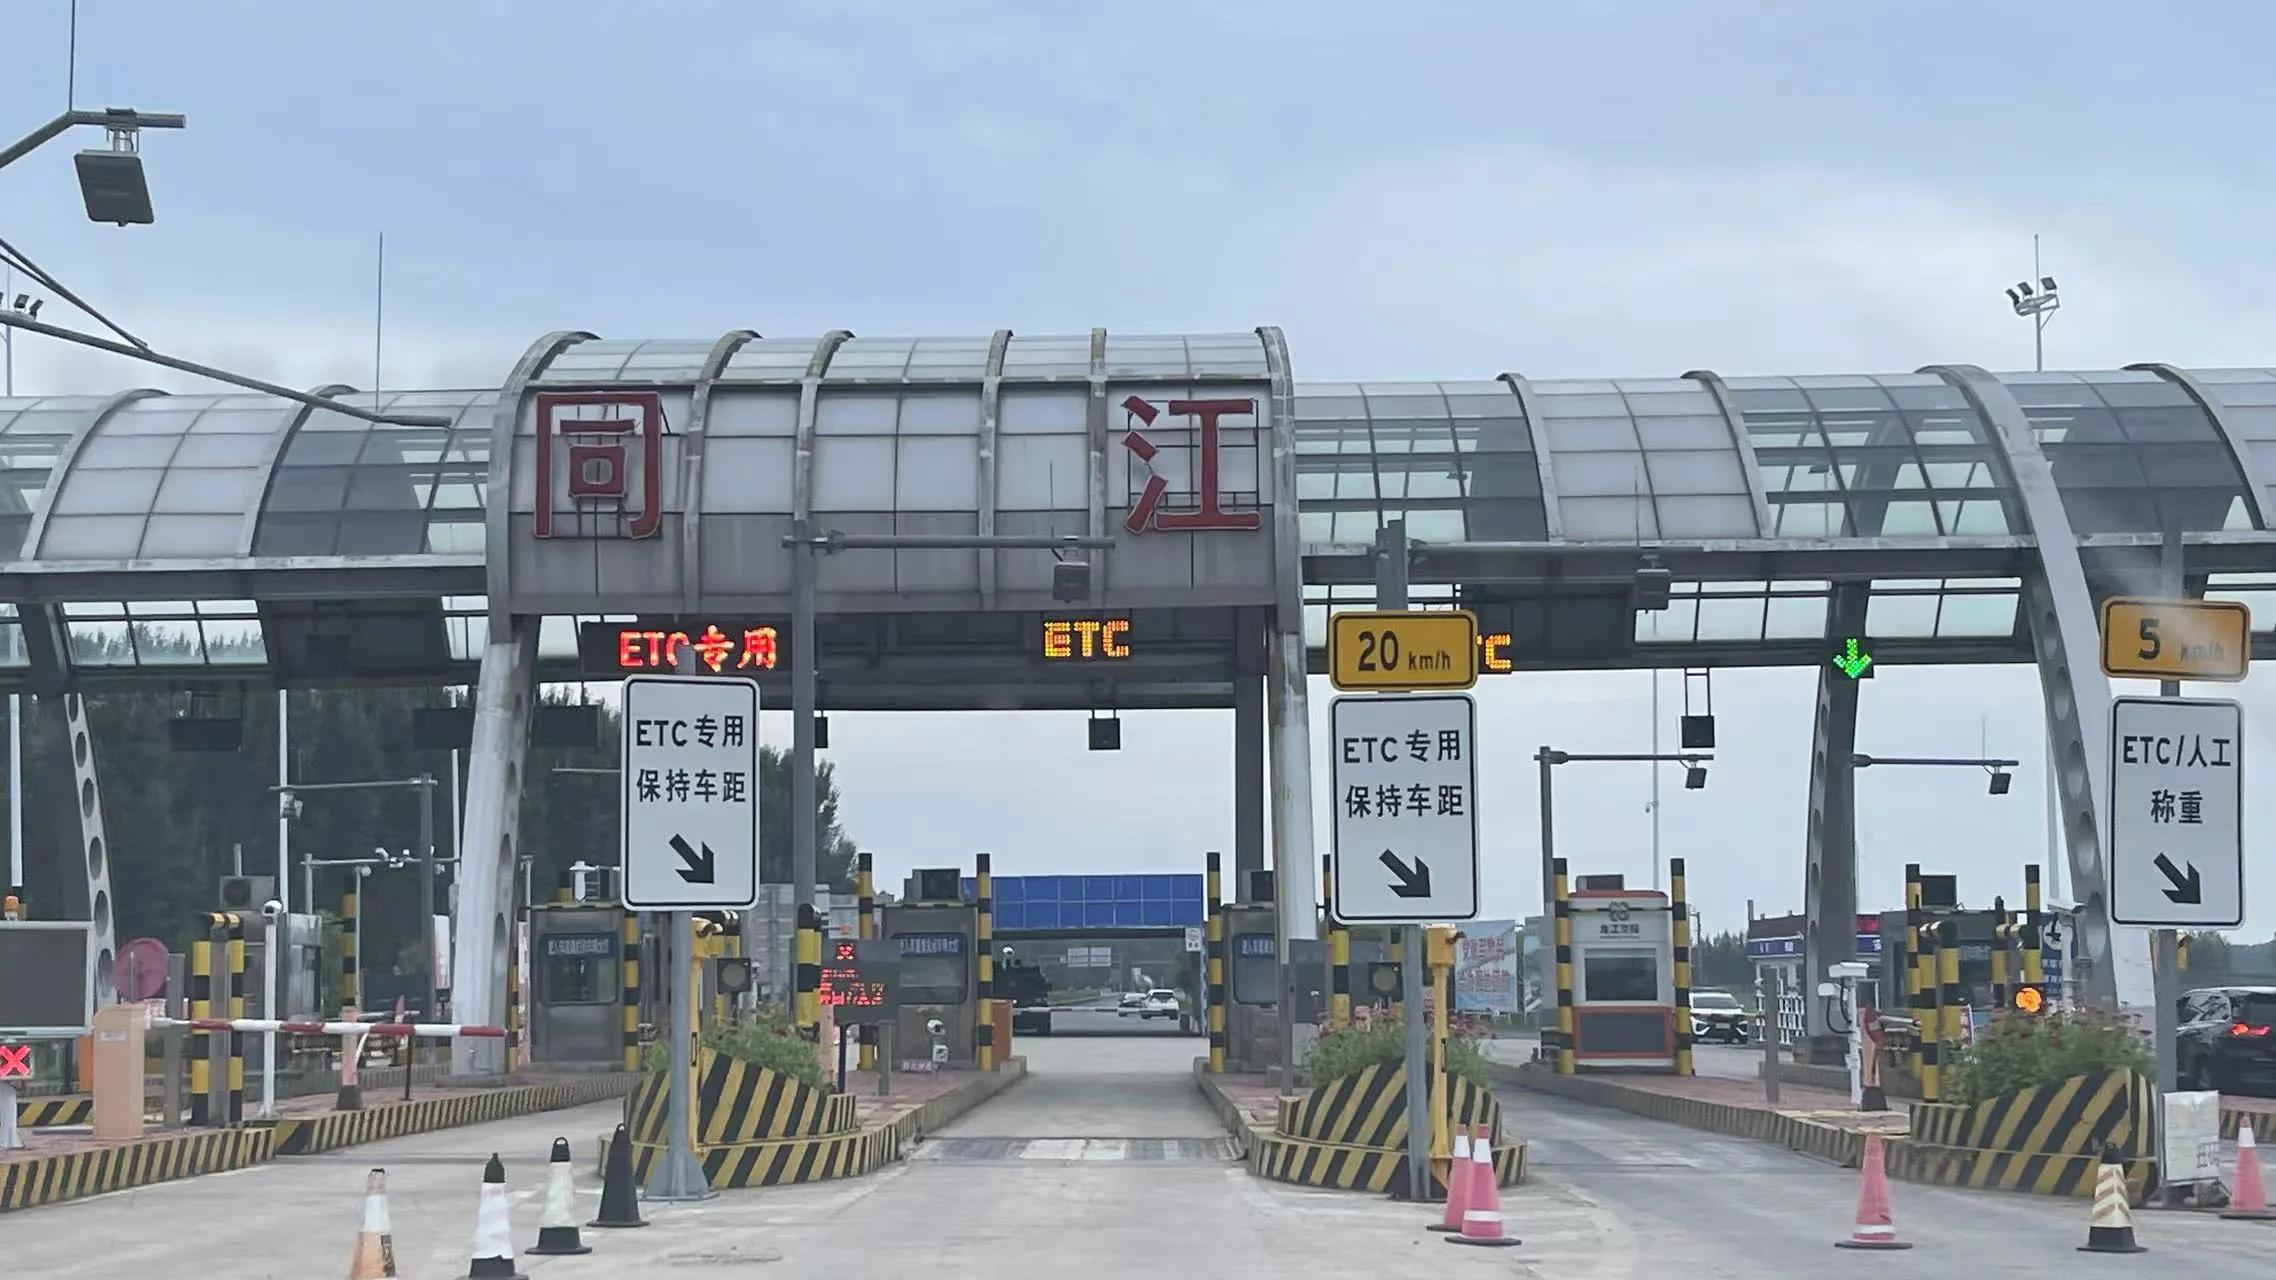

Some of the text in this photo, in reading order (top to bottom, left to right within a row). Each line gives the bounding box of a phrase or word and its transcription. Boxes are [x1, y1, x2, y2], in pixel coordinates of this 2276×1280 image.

[534, 390, 1261, 536] 同江
[1043, 619, 1130, 659] ETC
[1357, 630, 1400, 673] 20
[1407, 647, 1452, 673] km/h
[2137, 618, 2162, 661] 5
[2123, 734, 2232, 768] ETC/人工
[636, 767, 746, 803] 保持车距
[1344, 782, 1464, 819] 保持车距
[2150, 788, 2204, 825] 称重
